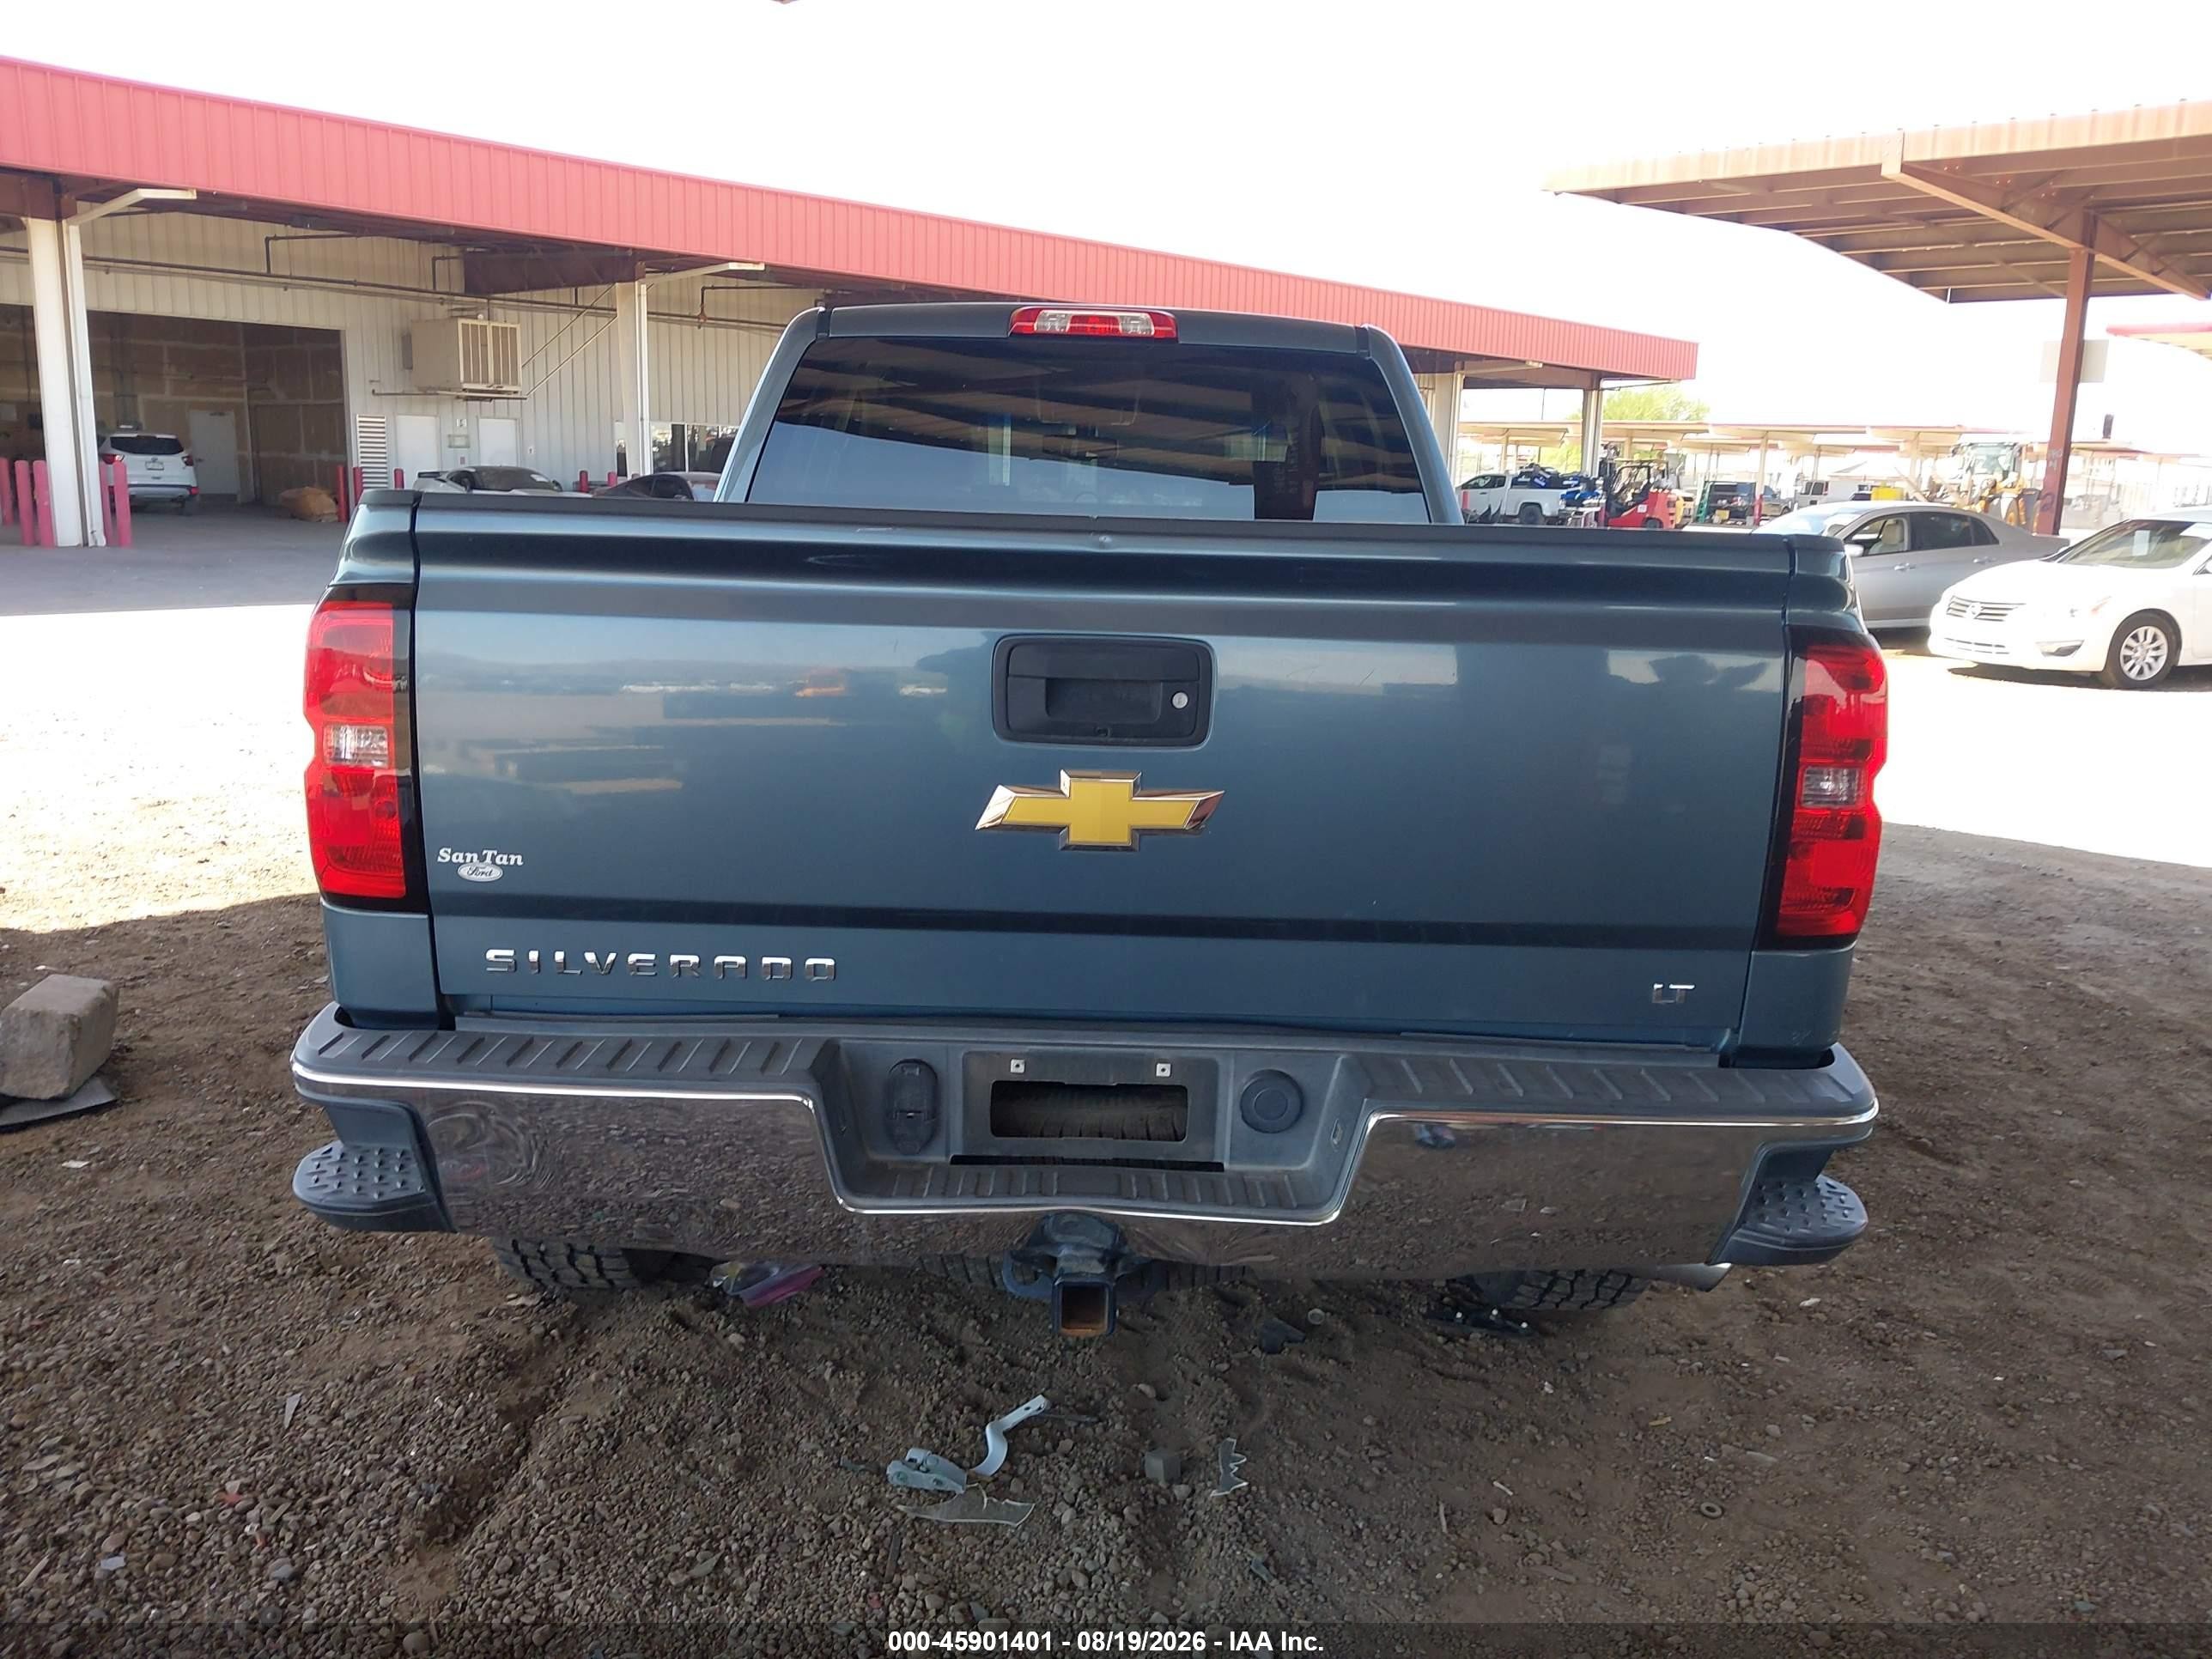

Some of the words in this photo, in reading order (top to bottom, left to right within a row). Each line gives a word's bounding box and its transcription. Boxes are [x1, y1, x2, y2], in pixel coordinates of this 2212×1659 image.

[437, 848, 480, 864] San
[482, 849, 524, 866] Tan
[466, 866, 494, 878] Ford
[484, 948, 836, 981] SILVERADO
[1651, 983, 1696, 1004] LT
